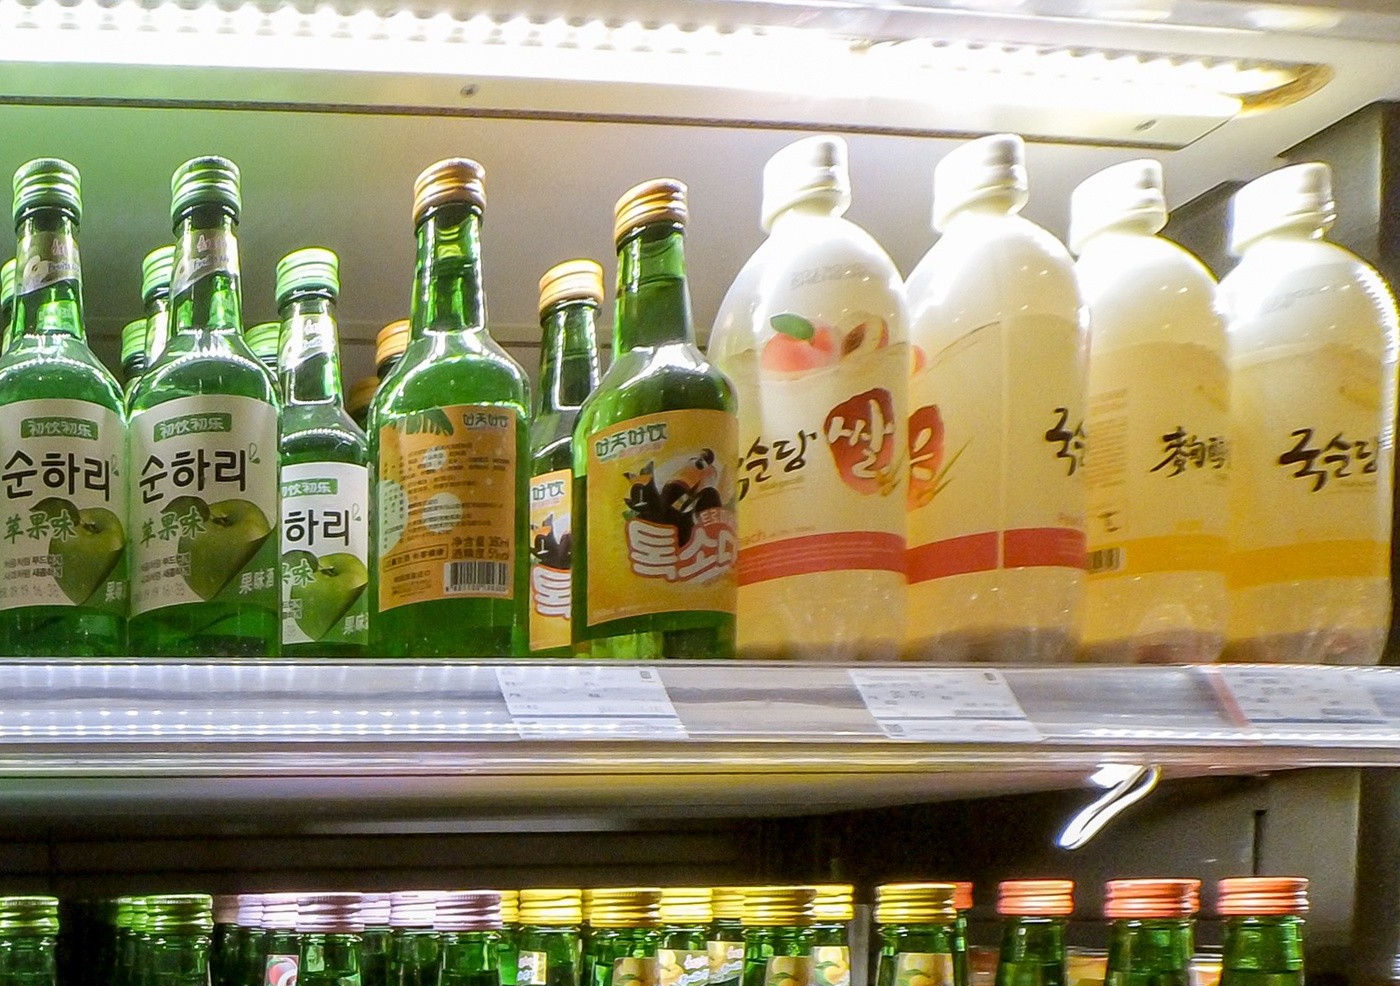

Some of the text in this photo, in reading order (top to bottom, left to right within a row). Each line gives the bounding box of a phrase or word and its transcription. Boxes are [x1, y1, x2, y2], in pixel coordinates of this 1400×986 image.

[27, 422, 93, 438] 初饮初乐
[160, 418, 223, 438] 初饮初乐
[1, 450, 110, 501] 순하리
[139, 448, 246, 503] 순하리
[737, 430, 817, 501] 순당
[4, 510, 77, 544] 苹果味
[139, 506, 206, 547] 苹果味
